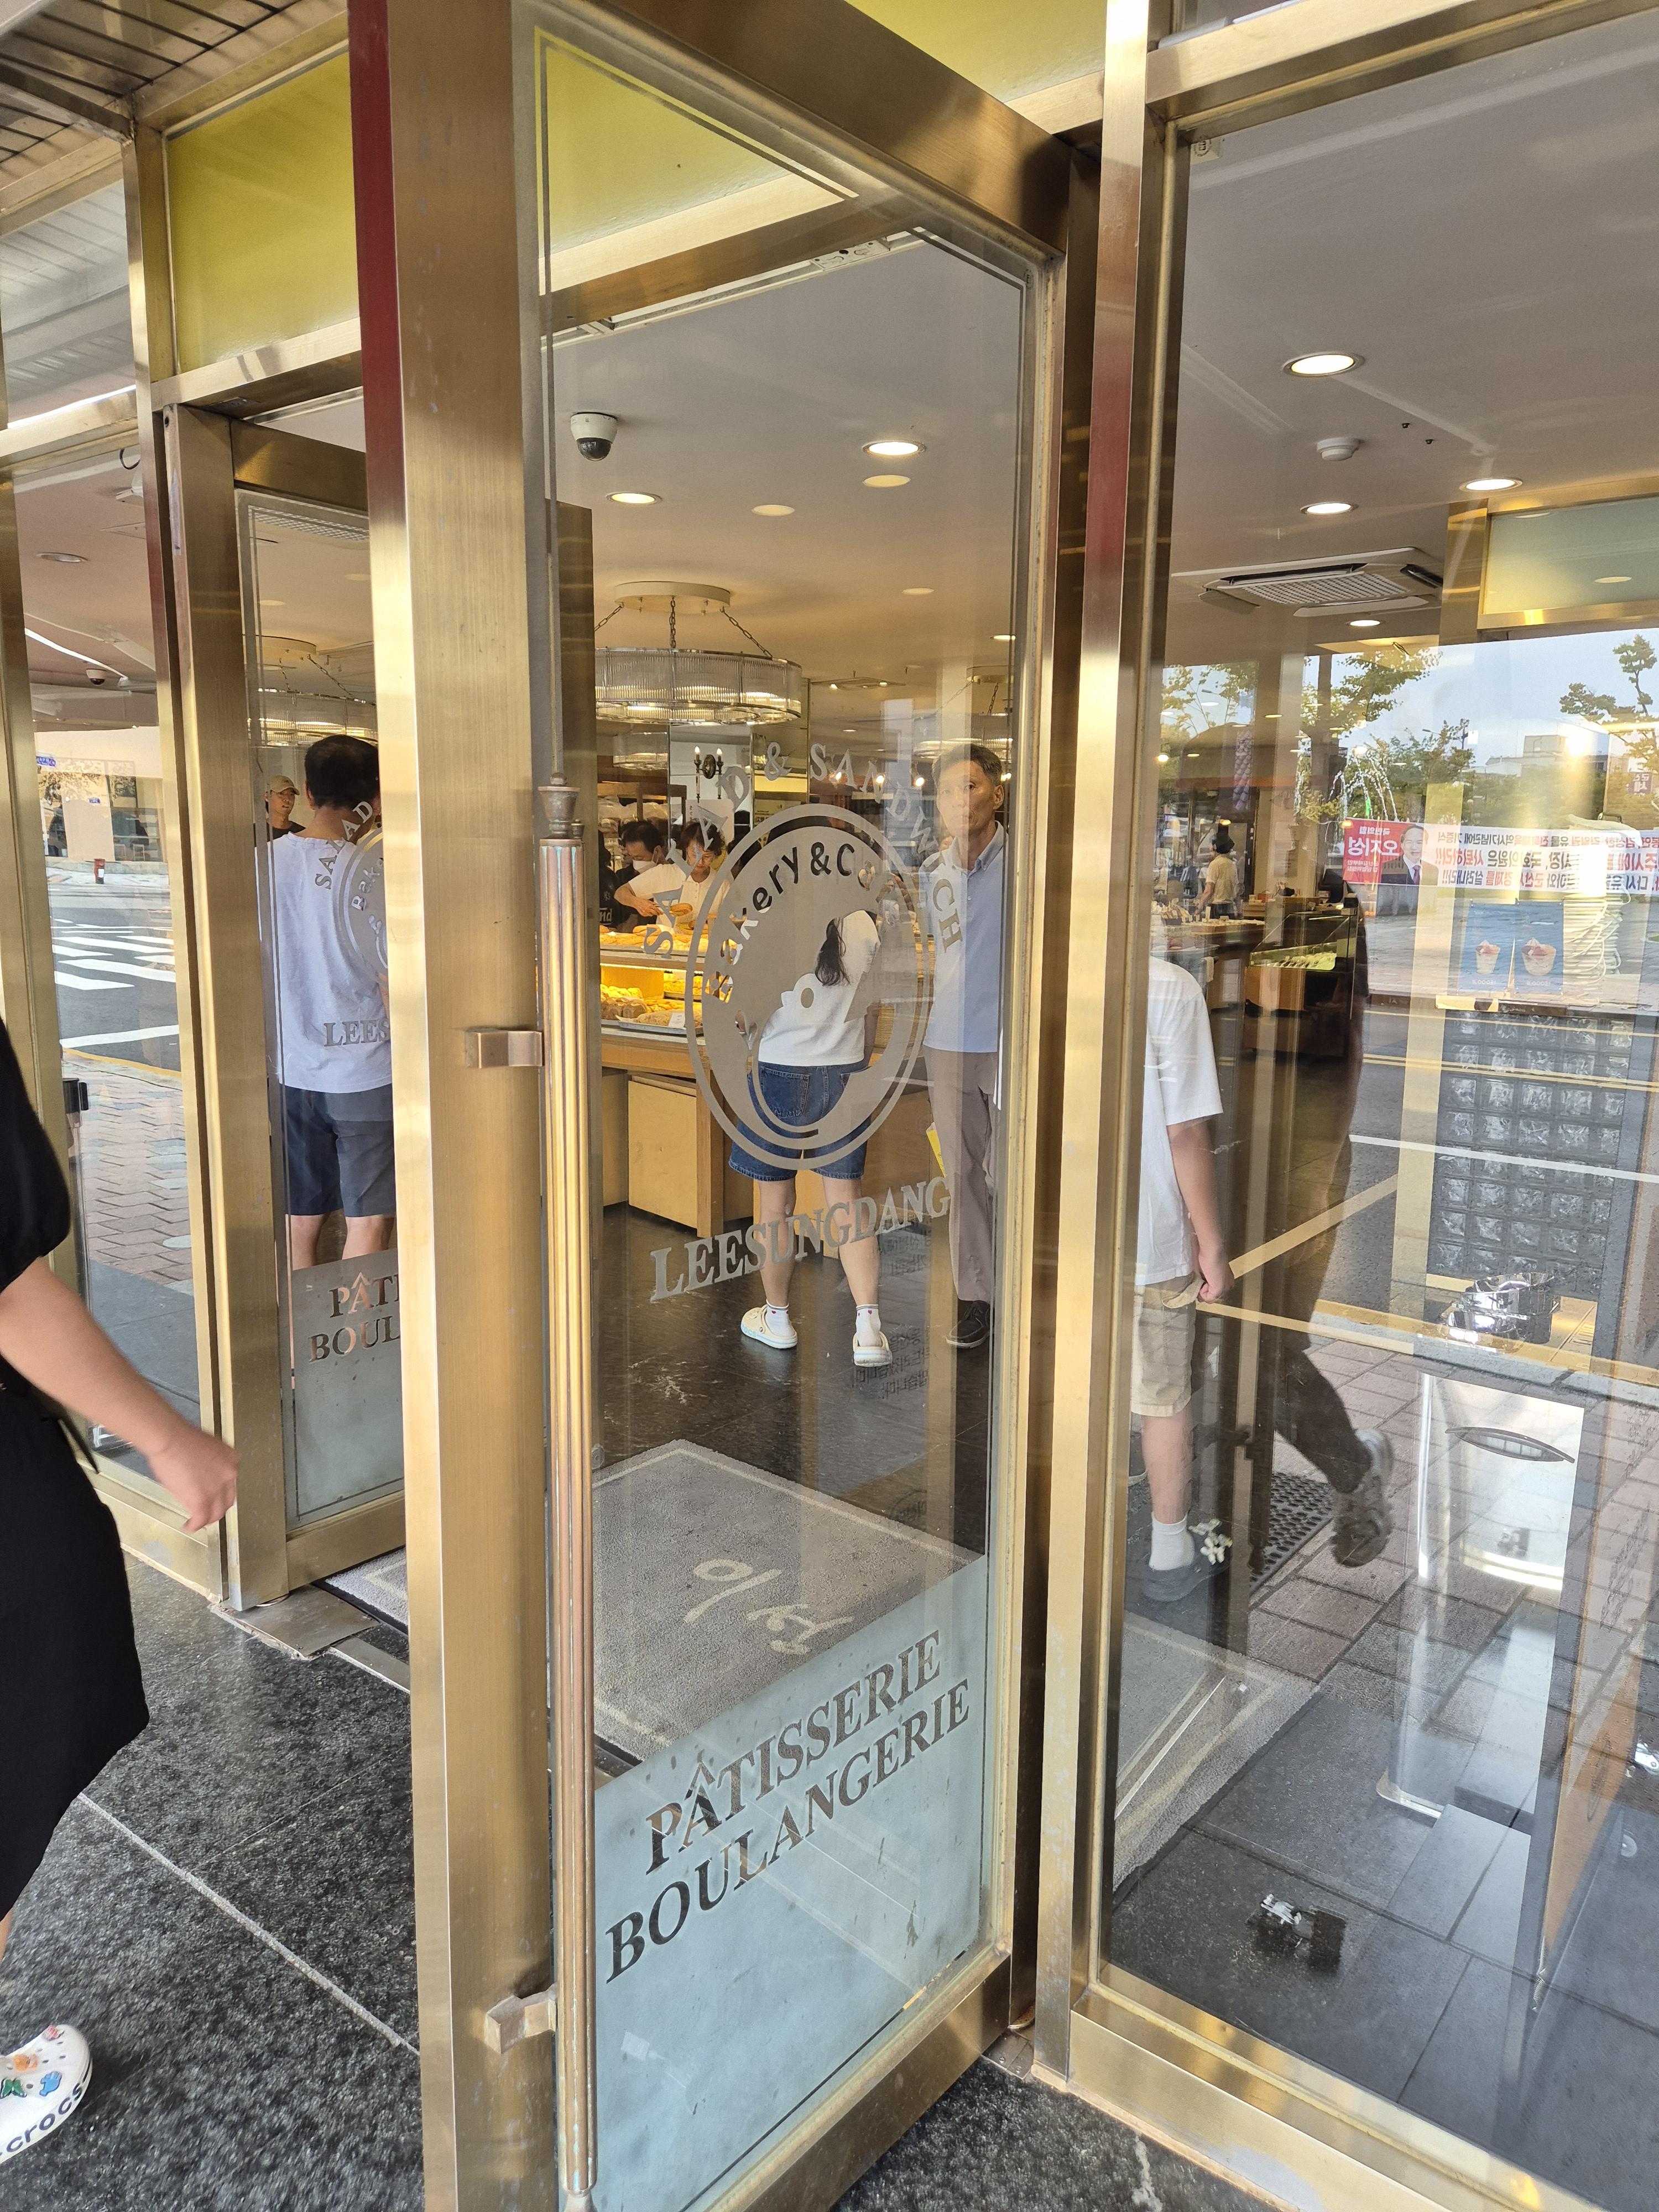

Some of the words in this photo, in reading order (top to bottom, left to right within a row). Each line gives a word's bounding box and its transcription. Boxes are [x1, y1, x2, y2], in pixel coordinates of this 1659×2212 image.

[315, 801, 373, 889] SALAD
[643, 766, 750, 959] SALAD
[765, 742, 792, 781] &
[810, 743, 964, 953] SANDWICH
[650, 1177, 951, 1302] LEESUNGDANG
[308, 1316, 400, 1363] BOUL
[646, 1630, 941, 1875] PÂTISSERIE
[606, 1679, 969, 1984] BOULANGERIE
[7, 2083, 82, 2153] crocs
